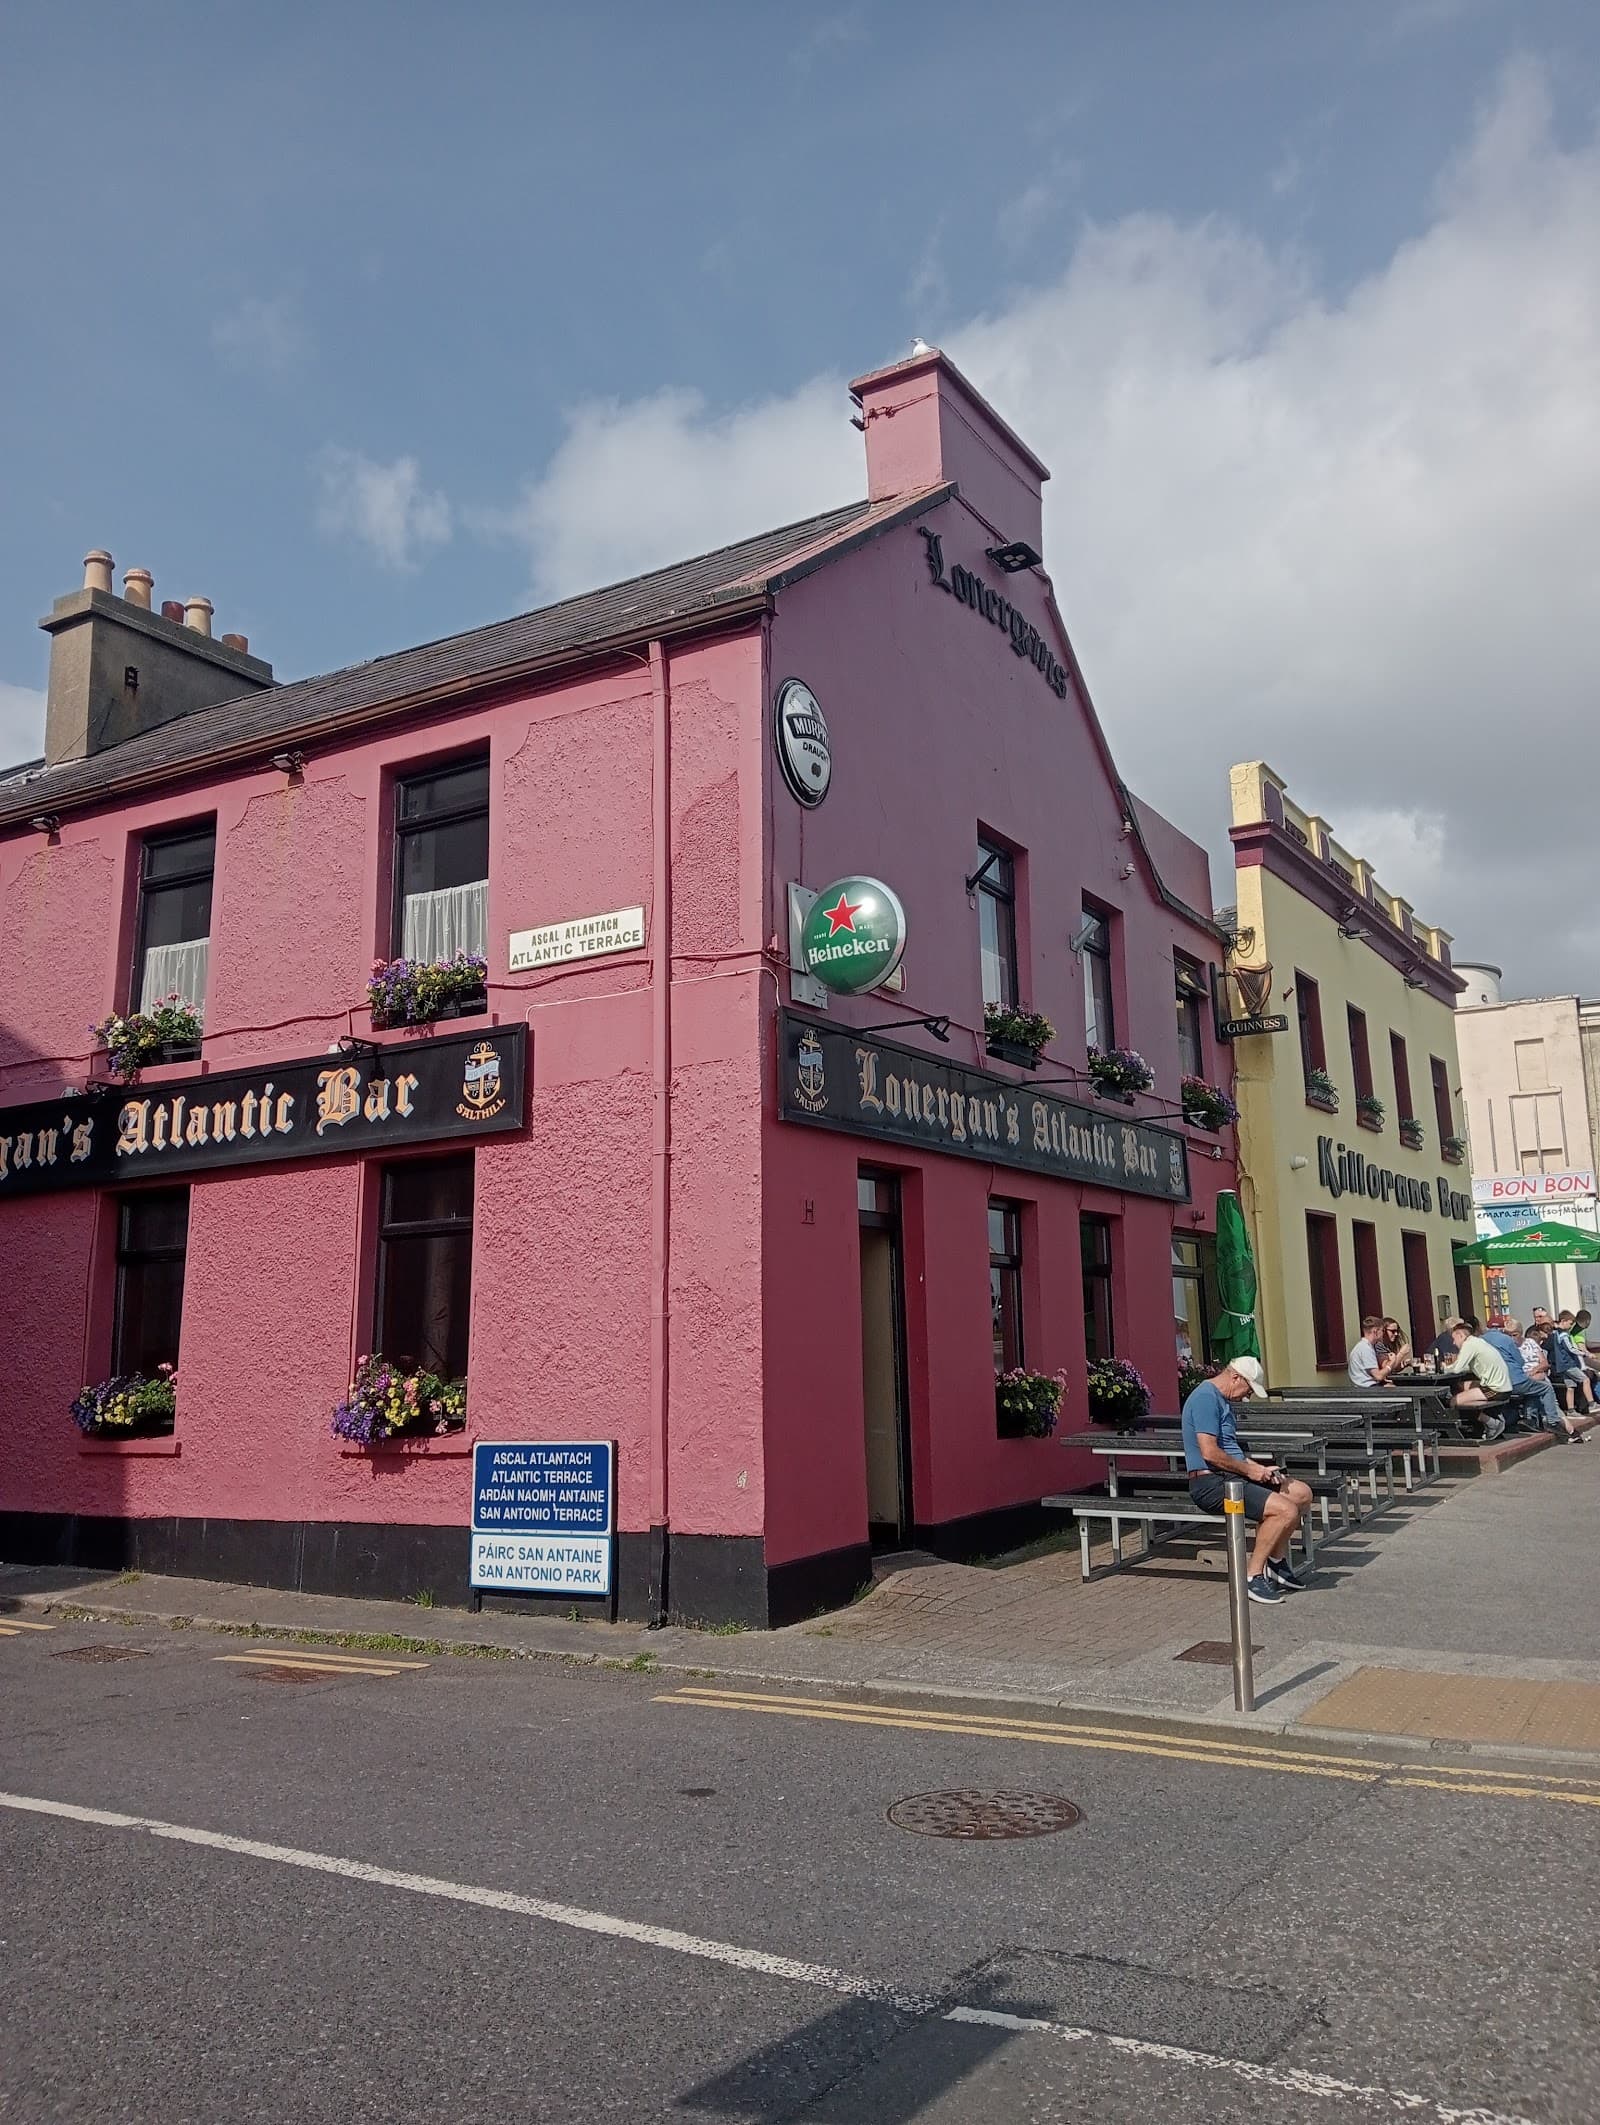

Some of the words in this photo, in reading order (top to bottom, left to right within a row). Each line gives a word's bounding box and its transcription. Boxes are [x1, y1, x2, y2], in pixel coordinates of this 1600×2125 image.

[531, 931, 560, 946] ASCAL
[565, 918, 619, 939] ATLANTACH
[511, 943, 573, 966] ATLANTIC
[579, 930, 640, 952] TERRACE
[808, 938, 890, 965] Heineken
[1226, 1017, 1281, 1033] GUINNESS
[455, 1098, 506, 1120] SALTHILL
[793, 1087, 829, 1112] SALTHILL
[116, 1082, 295, 1157] Atlantic
[316, 1067, 419, 1136] Bar
[855, 1047, 1020, 1146] Lonergan's
[1031, 1101, 1116, 1169] Atlantic
[1121, 1127, 1157, 1178] Bar
[1318, 1135, 1432, 1212] Killorans
[1437, 1176, 1472, 1222] Bar
[1492, 1180, 1537, 1197] BON
[1544, 1175, 1590, 1193] BON
[493, 1452, 527, 1465] ASCAL
[529, 1452, 592, 1465] ATLANTACH
[491, 1470, 541, 1483] ATLANTIC
[544, 1471, 593, 1484] TERRACE
[479, 1486, 515, 1501] ARDÁN
[517, 1489, 556, 1502] NAOMH
[559, 1490, 605, 1503] ANTAINE
[480, 1507, 501, 1520] SAN
[503, 1507, 550, 1521] ANTONIO
[554, 1509, 603, 1521] TERRACE
[478, 1543, 514, 1560] PÁIRC
[518, 1547, 543, 1561] SAN
[546, 1548, 602, 1563] ANTAINE
[478, 1564, 503, 1578] SAN
[506, 1566, 562, 1581] ANTONIO
[566, 1568, 601, 1583] PARK
